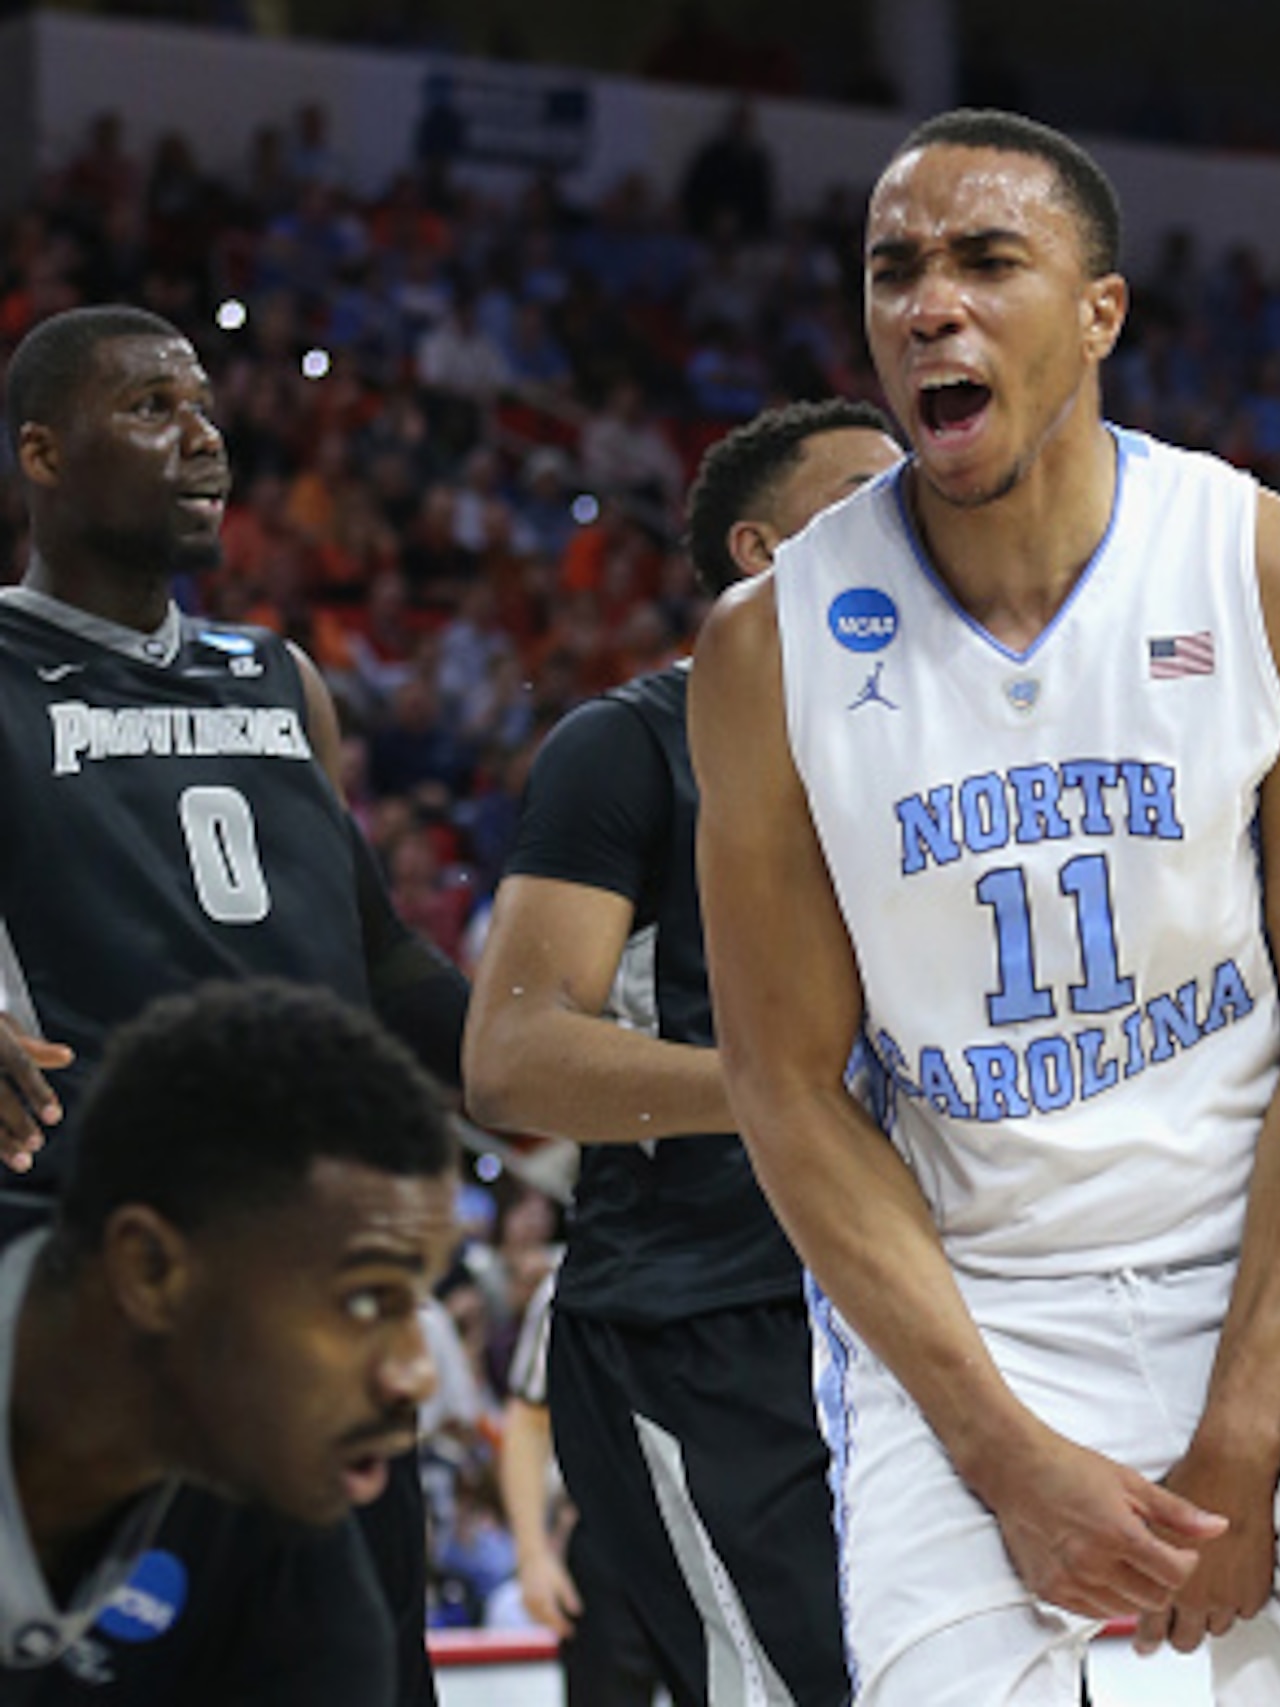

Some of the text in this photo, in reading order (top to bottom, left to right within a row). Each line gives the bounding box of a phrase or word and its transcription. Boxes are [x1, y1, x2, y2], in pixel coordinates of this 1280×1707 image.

[838, 615, 895, 638] NCAA
[179, 785, 270, 924] 0
[896, 757, 1184, 875] NORTH
[975, 853, 1136, 1028] 11
